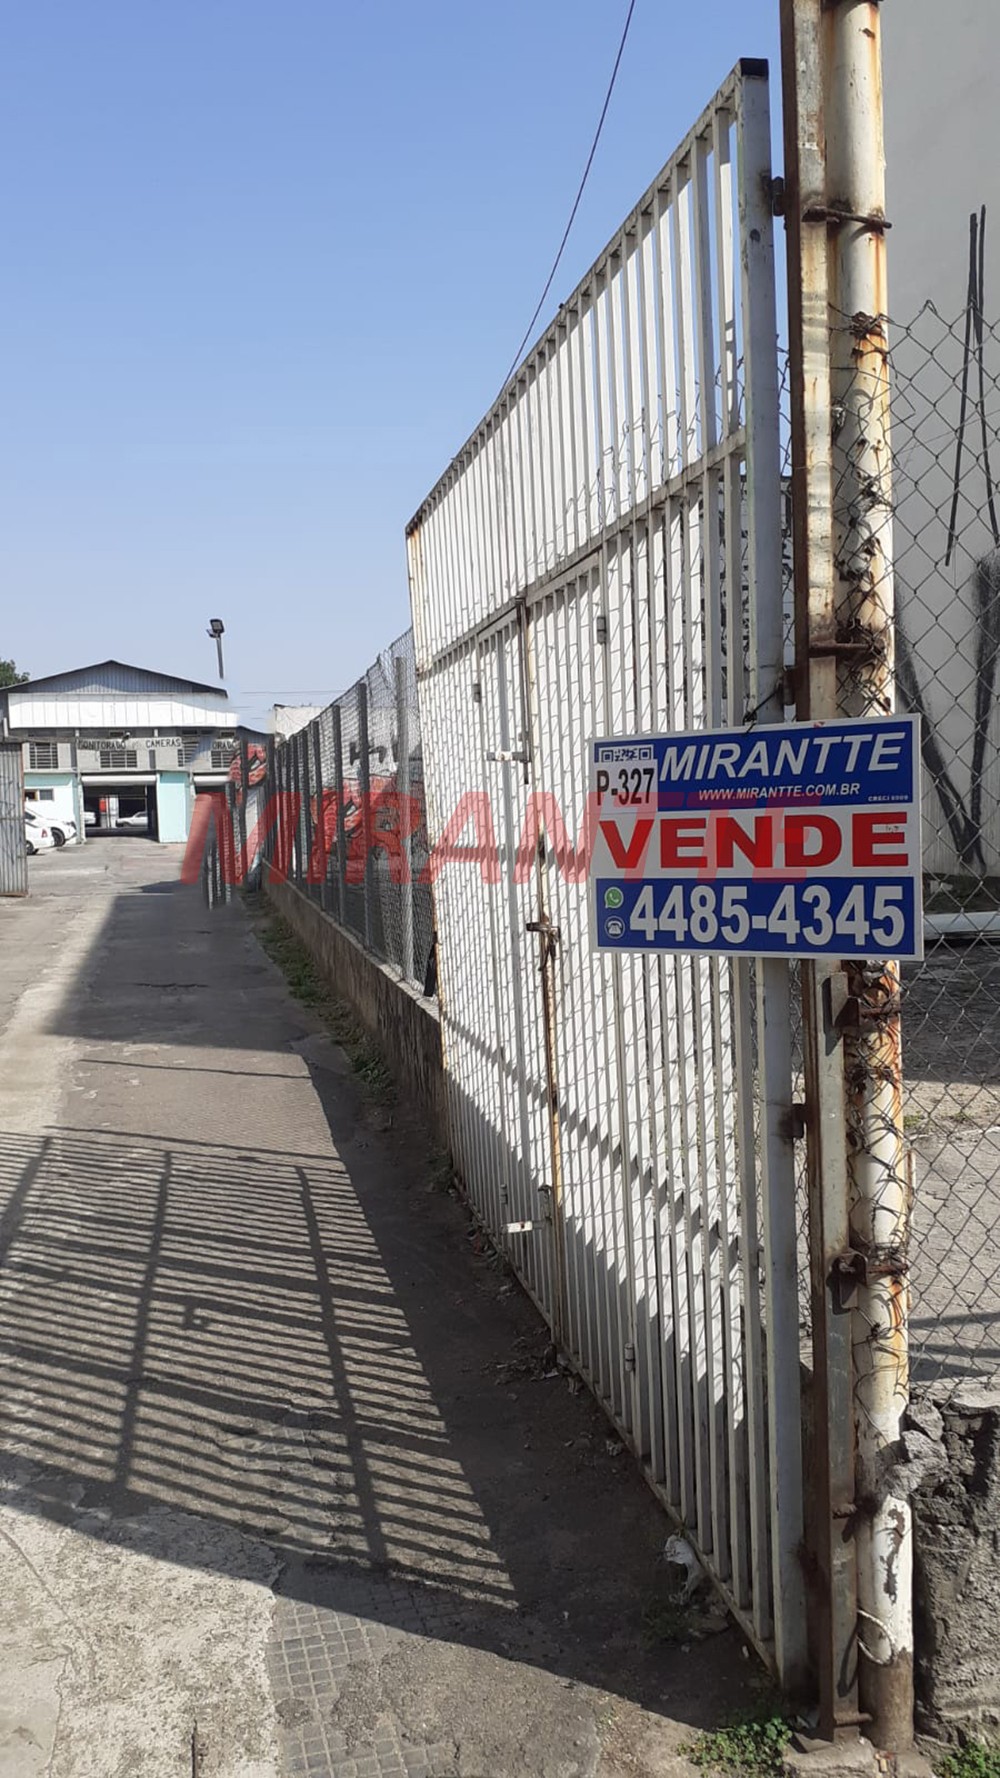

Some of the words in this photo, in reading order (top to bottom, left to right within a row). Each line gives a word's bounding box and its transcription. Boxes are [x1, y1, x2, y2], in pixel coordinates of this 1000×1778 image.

[145, 739, 182, 749] CAMERAS
[660, 732, 906, 782] MIRANTTE
[597, 768, 655, 806] P-327
[699, 782, 861, 801] WWW.MIRANTTE.COM.BR
[599, 812, 909, 869] VENDE
[630, 884, 905, 947] 4485-4345
